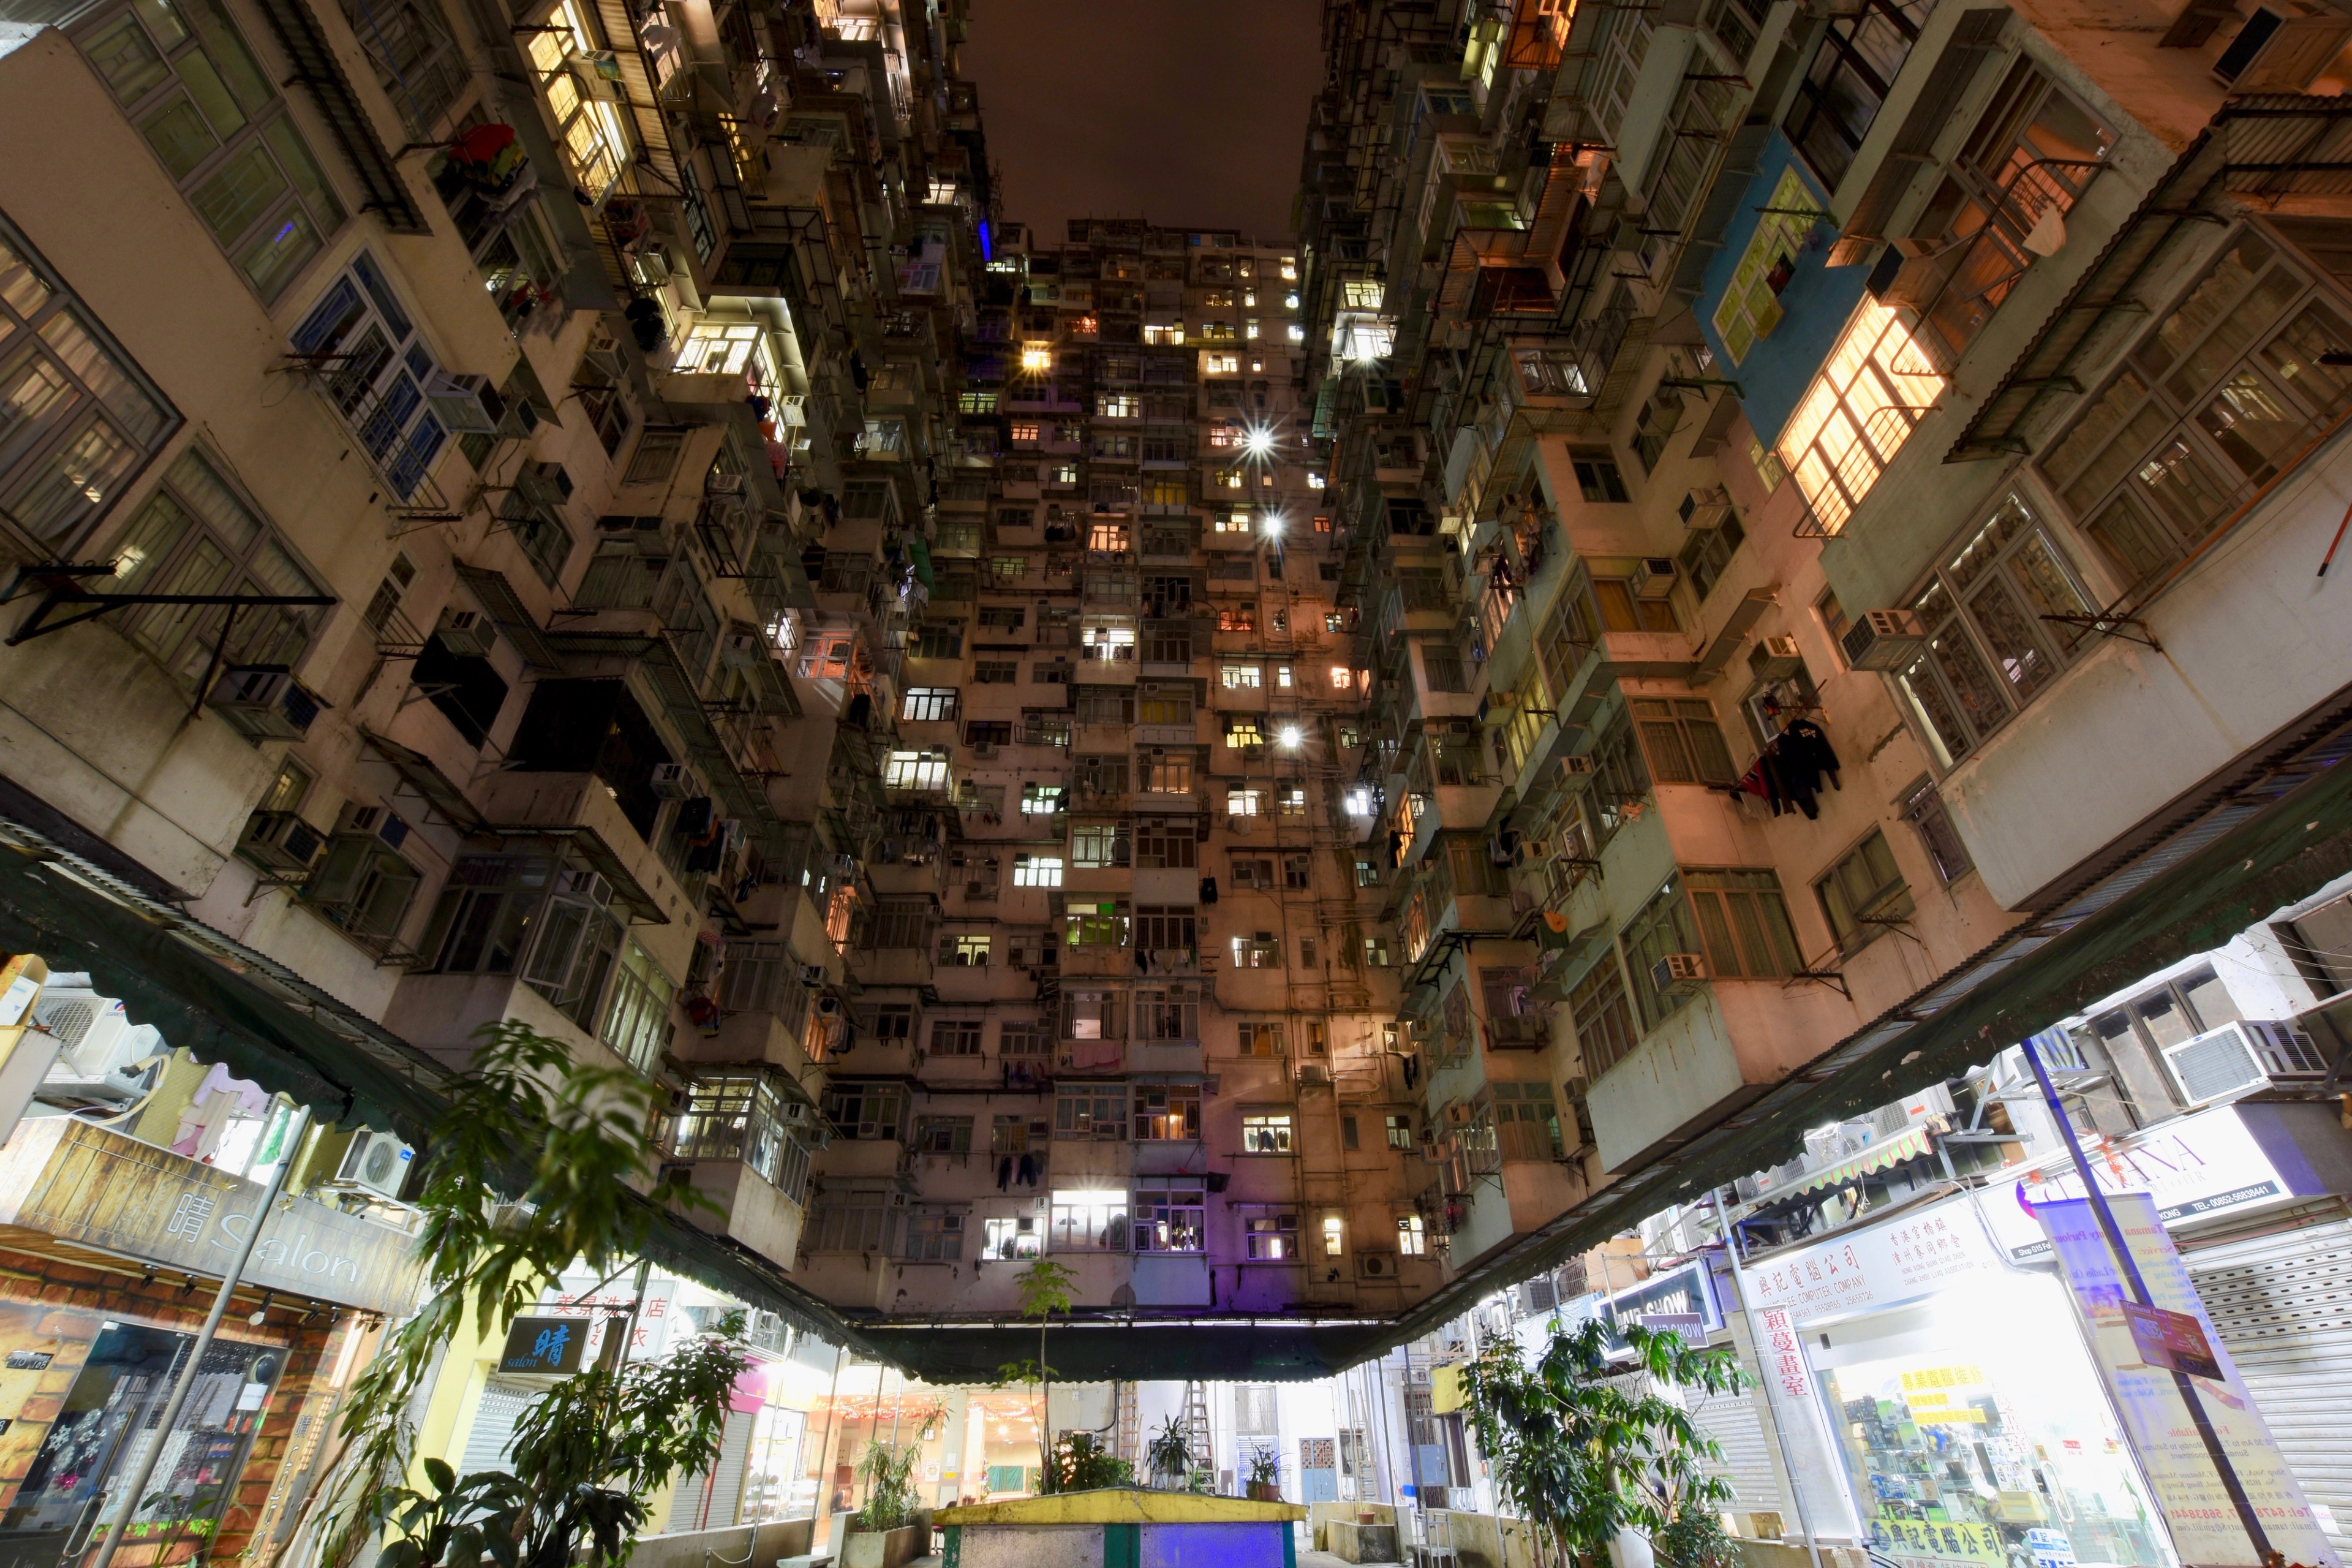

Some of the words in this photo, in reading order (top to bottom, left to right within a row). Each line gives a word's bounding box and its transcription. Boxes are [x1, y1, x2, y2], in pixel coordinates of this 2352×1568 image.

[167, 1192, 215, 1243] 晴
[2157, 1208, 2181, 1221] KONG
[210, 1213, 358, 1282] Salon
[2018, 1248, 2032, 1256] Shop
[1901, 1267, 1913, 1275] HONG
[1914, 1262, 1926, 1272] KONG
[1798, 1285, 1833, 1304] COMPUTER
[1833, 1274, 1866, 1294] COMPANY
[1646, 1290, 1687, 1314] SHOW
[1814, 1299, 1841, 1314] 95528965
[1670, 1322, 1702, 1338] SHOW
[532, 1324, 571, 1368] 晴
[506, 1352, 538, 1368] salon
[1890, 1520, 2000, 1558] 興記電腦公司
[2029, 1531, 2050, 1543] 興記
